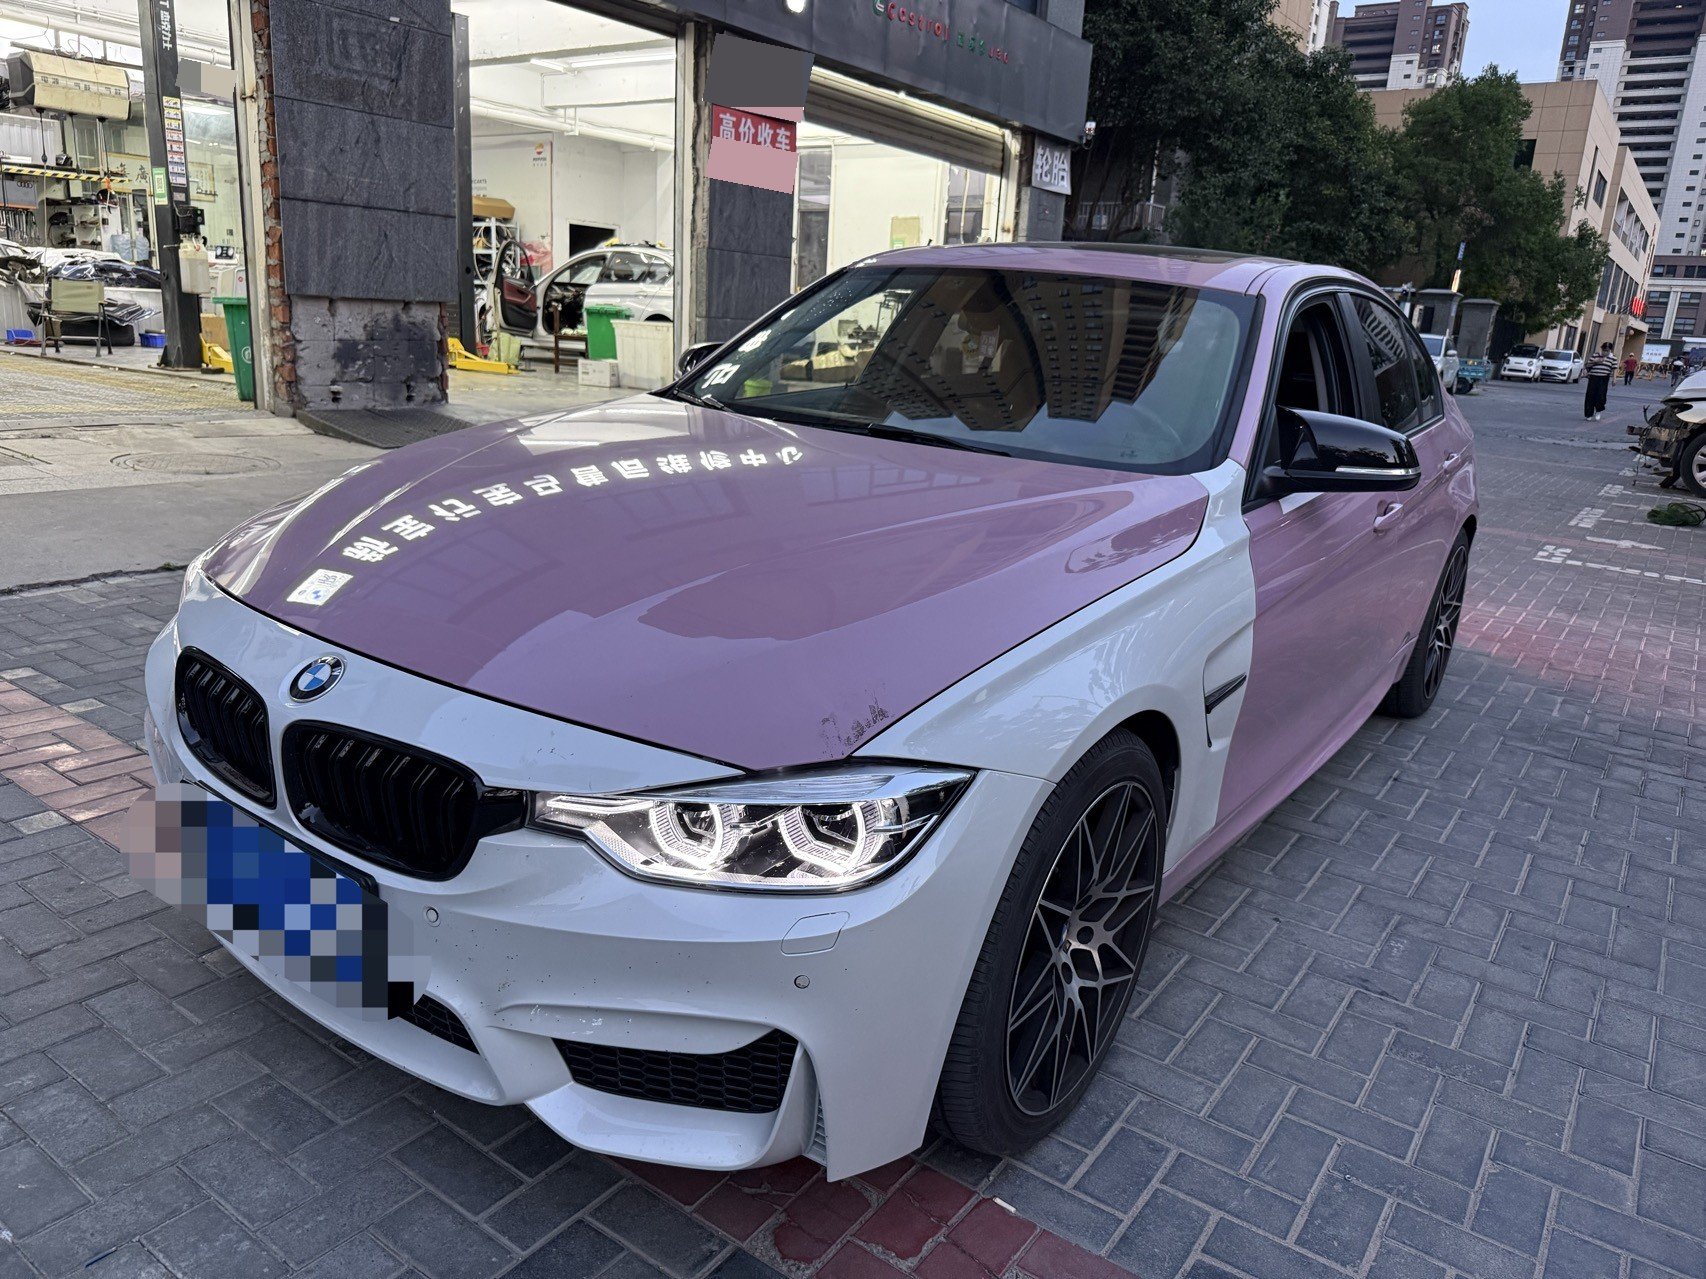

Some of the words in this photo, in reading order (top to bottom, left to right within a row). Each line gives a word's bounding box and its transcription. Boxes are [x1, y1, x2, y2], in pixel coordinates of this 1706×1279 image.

[719, 112, 791, 151] 高价收车
[1034, 145, 1068, 188] 轮胎
